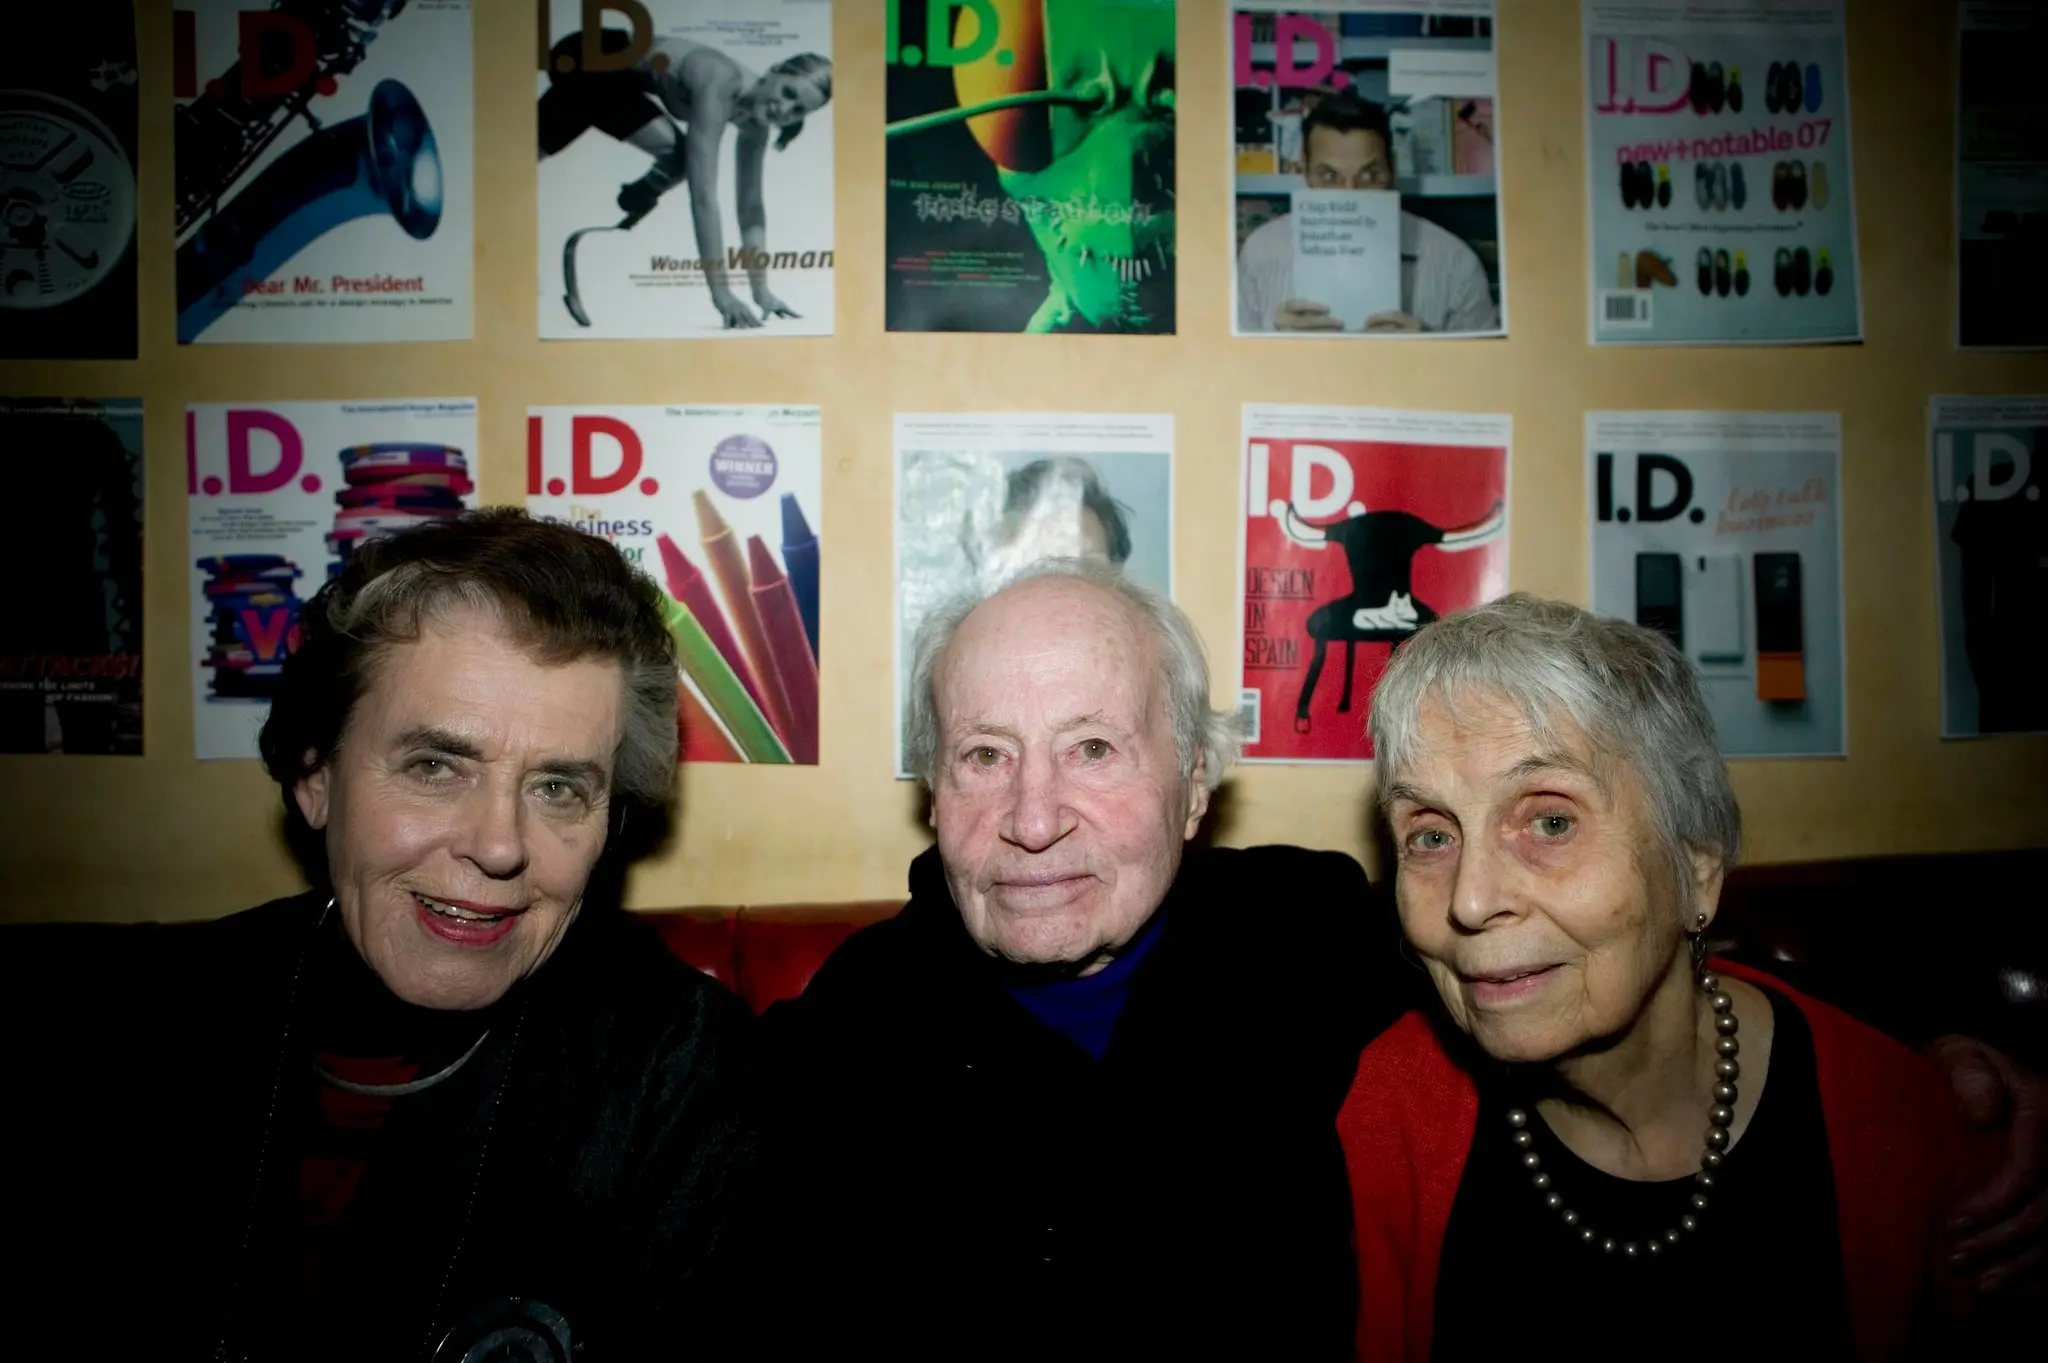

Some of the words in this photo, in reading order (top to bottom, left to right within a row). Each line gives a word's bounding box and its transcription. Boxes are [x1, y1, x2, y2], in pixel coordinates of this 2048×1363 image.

[1234, 14, 1351, 89] I.D.
[1797, 119, 1832, 148] 07
[650, 255, 724, 272] Wonder
[727, 245, 833, 270] Woman
[244, 279, 285, 294] Dear
[292, 276, 324, 293] Mr.
[331, 273, 424, 292] President
[186, 410, 322, 496] I.D.
[527, 416, 660, 496] I.D.
[714, 458, 774, 475] WINNER
[1936, 432, 2042, 503] I.D.
[1248, 443, 1368, 518] I.D.
[1597, 453, 1705, 523] I.D.
[1246, 566, 1316, 597] DESIGN
[1246, 603, 1265, 629] IN
[1246, 638, 1299, 665] SPAIN
